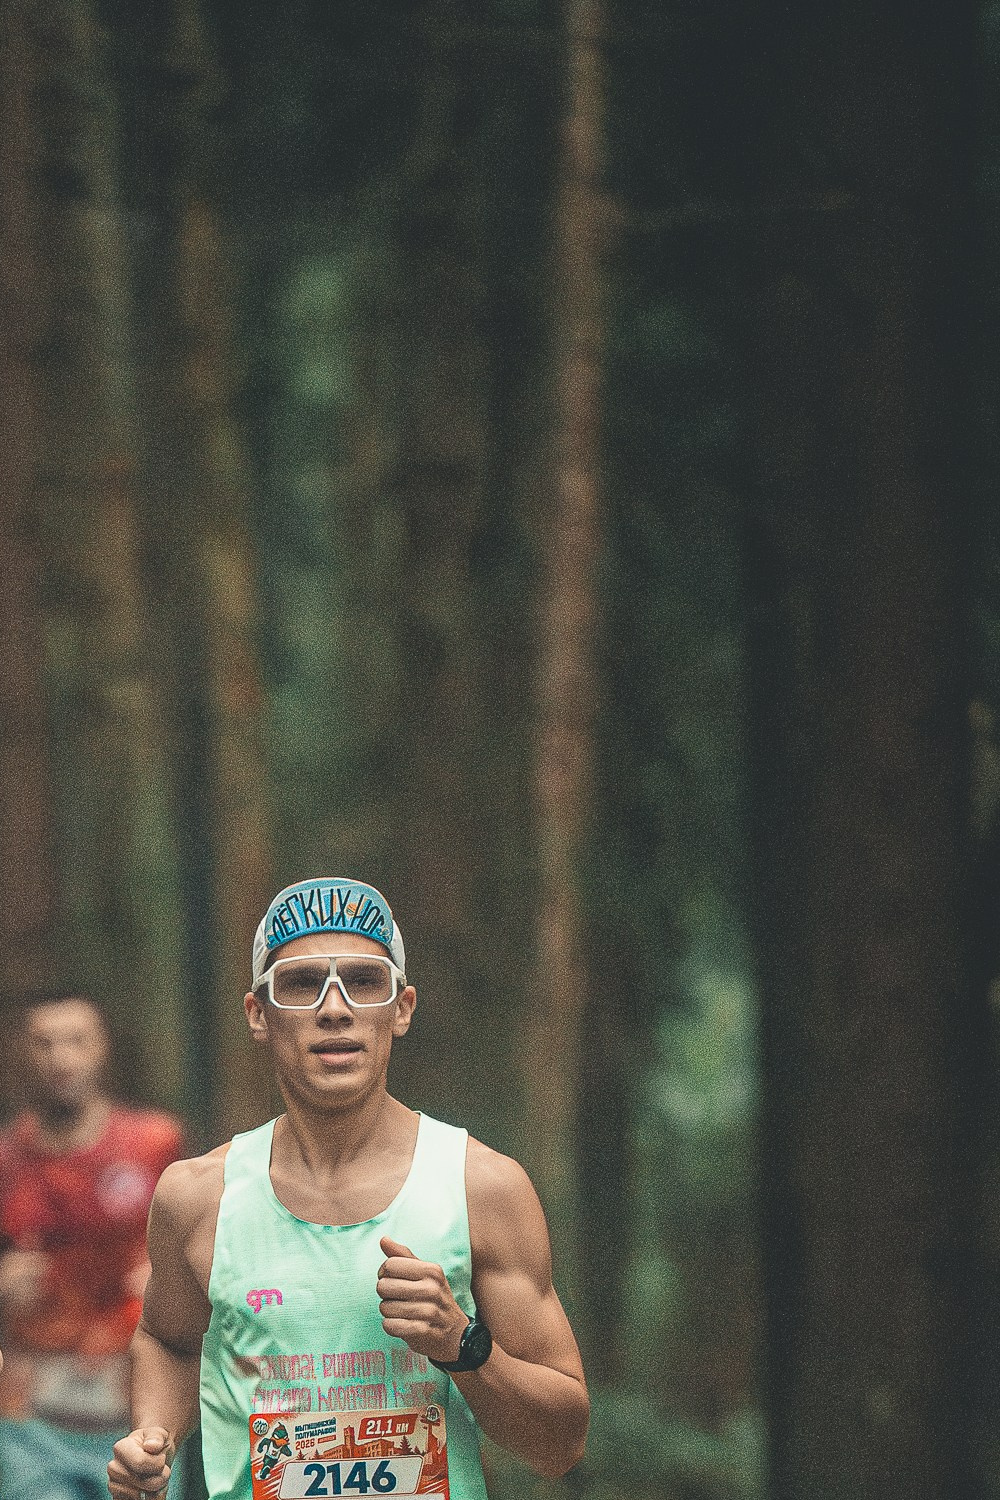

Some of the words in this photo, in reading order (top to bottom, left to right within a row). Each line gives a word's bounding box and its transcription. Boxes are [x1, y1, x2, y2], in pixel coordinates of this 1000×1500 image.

[350, 893, 385, 934] НОГ
[366, 1418, 393, 1437] 21,1
[303, 1460, 397, 1497] 2146
